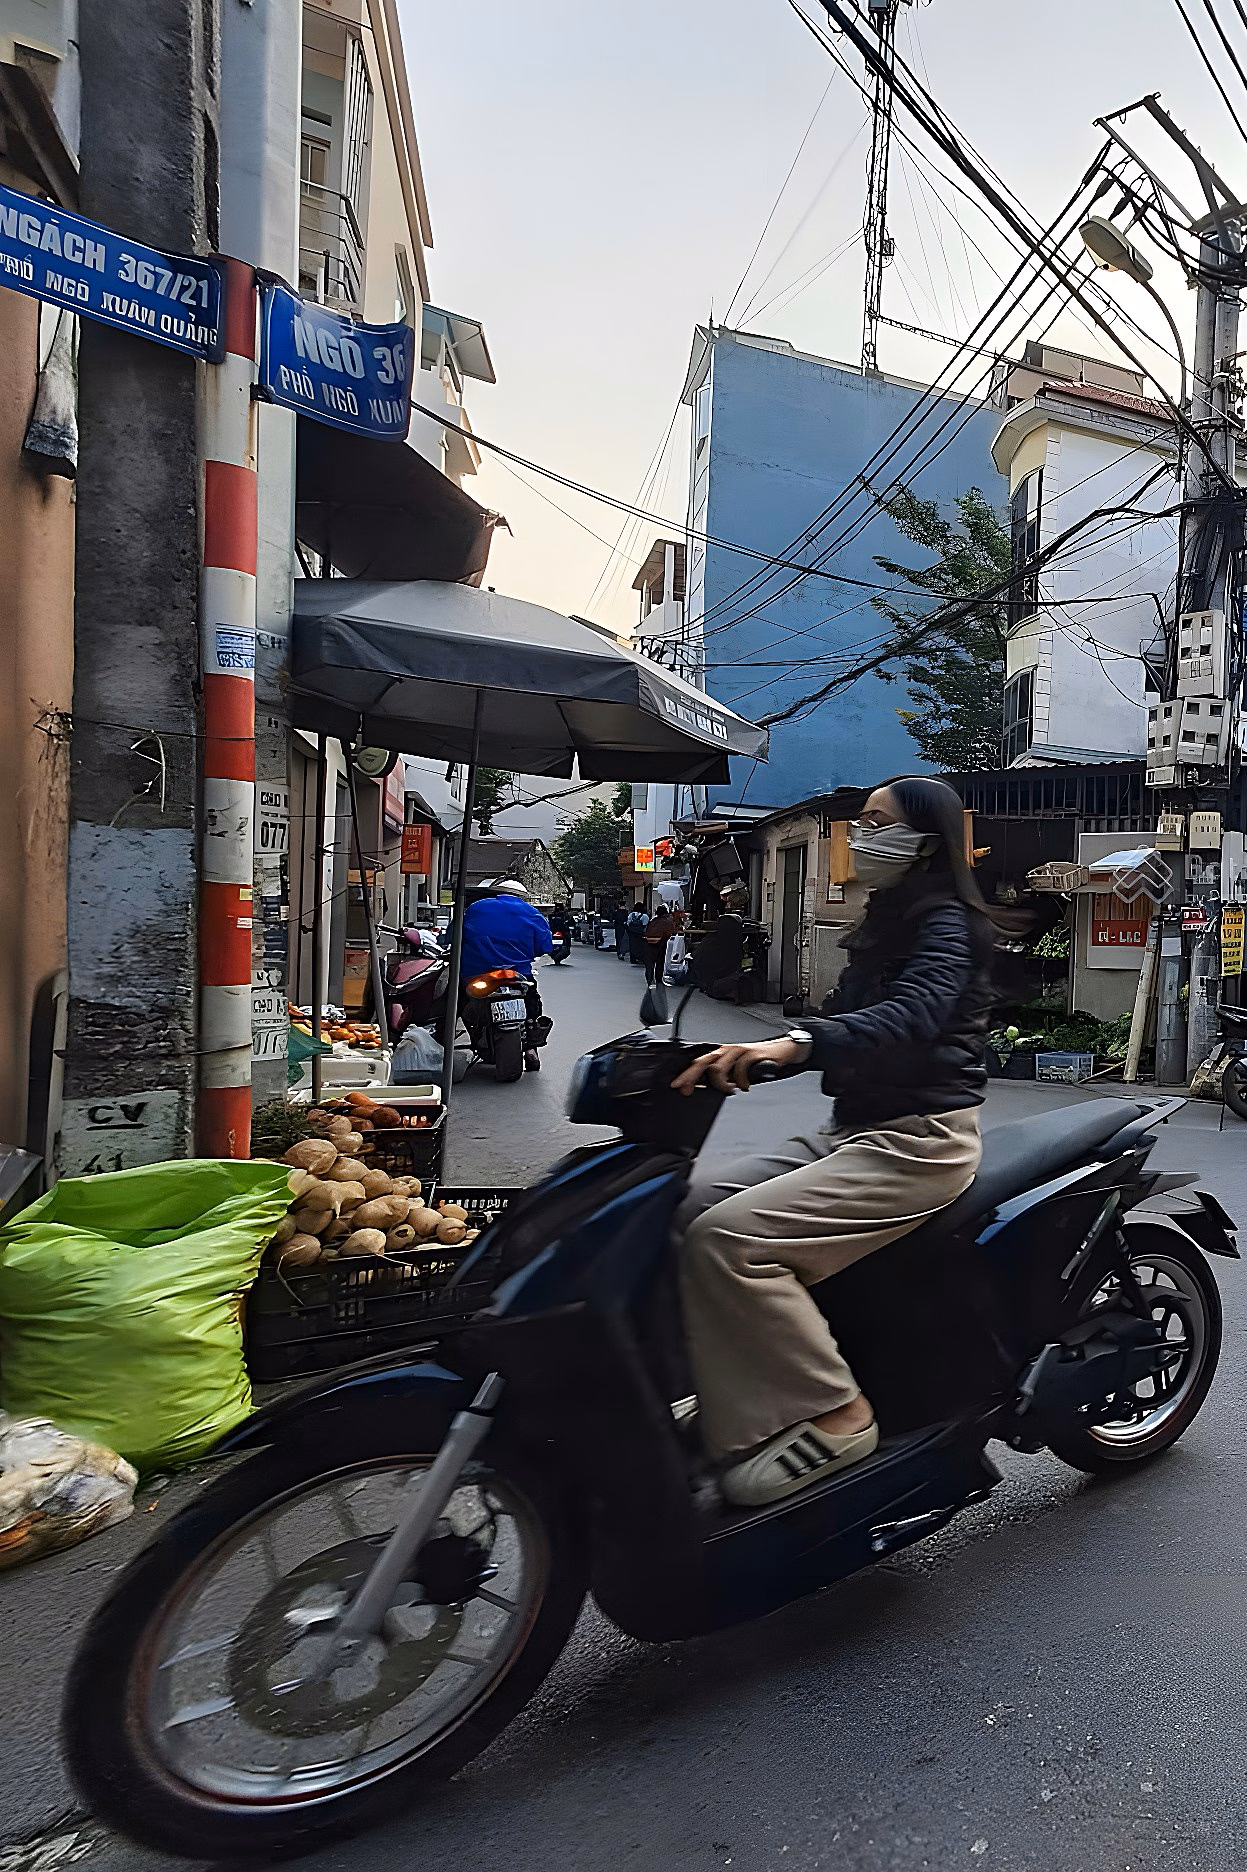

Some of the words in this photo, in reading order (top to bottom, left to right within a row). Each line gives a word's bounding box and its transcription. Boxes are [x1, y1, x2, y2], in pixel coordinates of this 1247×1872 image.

[0, 204, 106, 273] NGÁCH
[117, 253, 209, 309] 367/21
[100, 291, 156, 327] XUÂN
[160, 311, 218, 346] QUẢNG
[87, 1101, 147, 1125] CV
